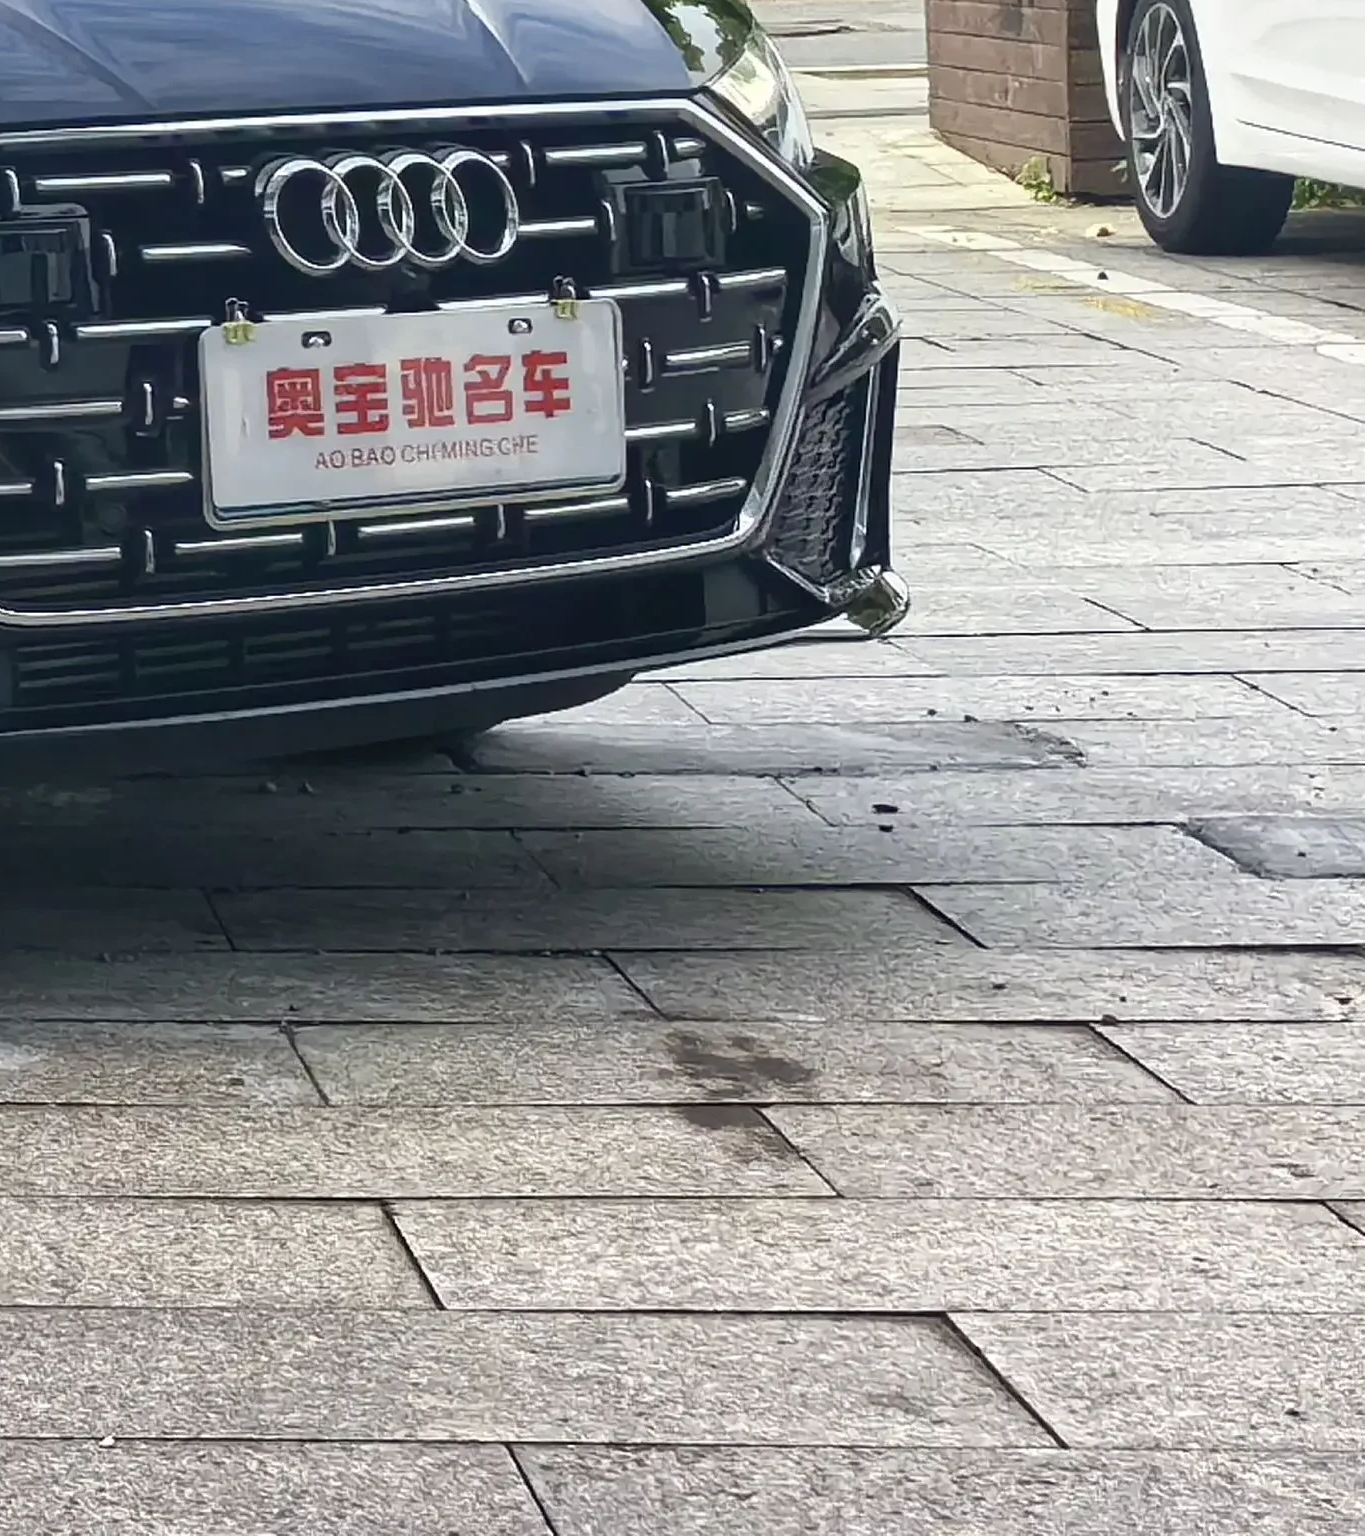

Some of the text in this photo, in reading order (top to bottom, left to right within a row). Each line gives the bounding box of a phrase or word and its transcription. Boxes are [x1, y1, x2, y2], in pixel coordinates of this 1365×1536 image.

[265, 350, 572, 439] 奥宝驰名车
[314, 450, 346, 470] AO
[350, 445, 396, 468] BAO
